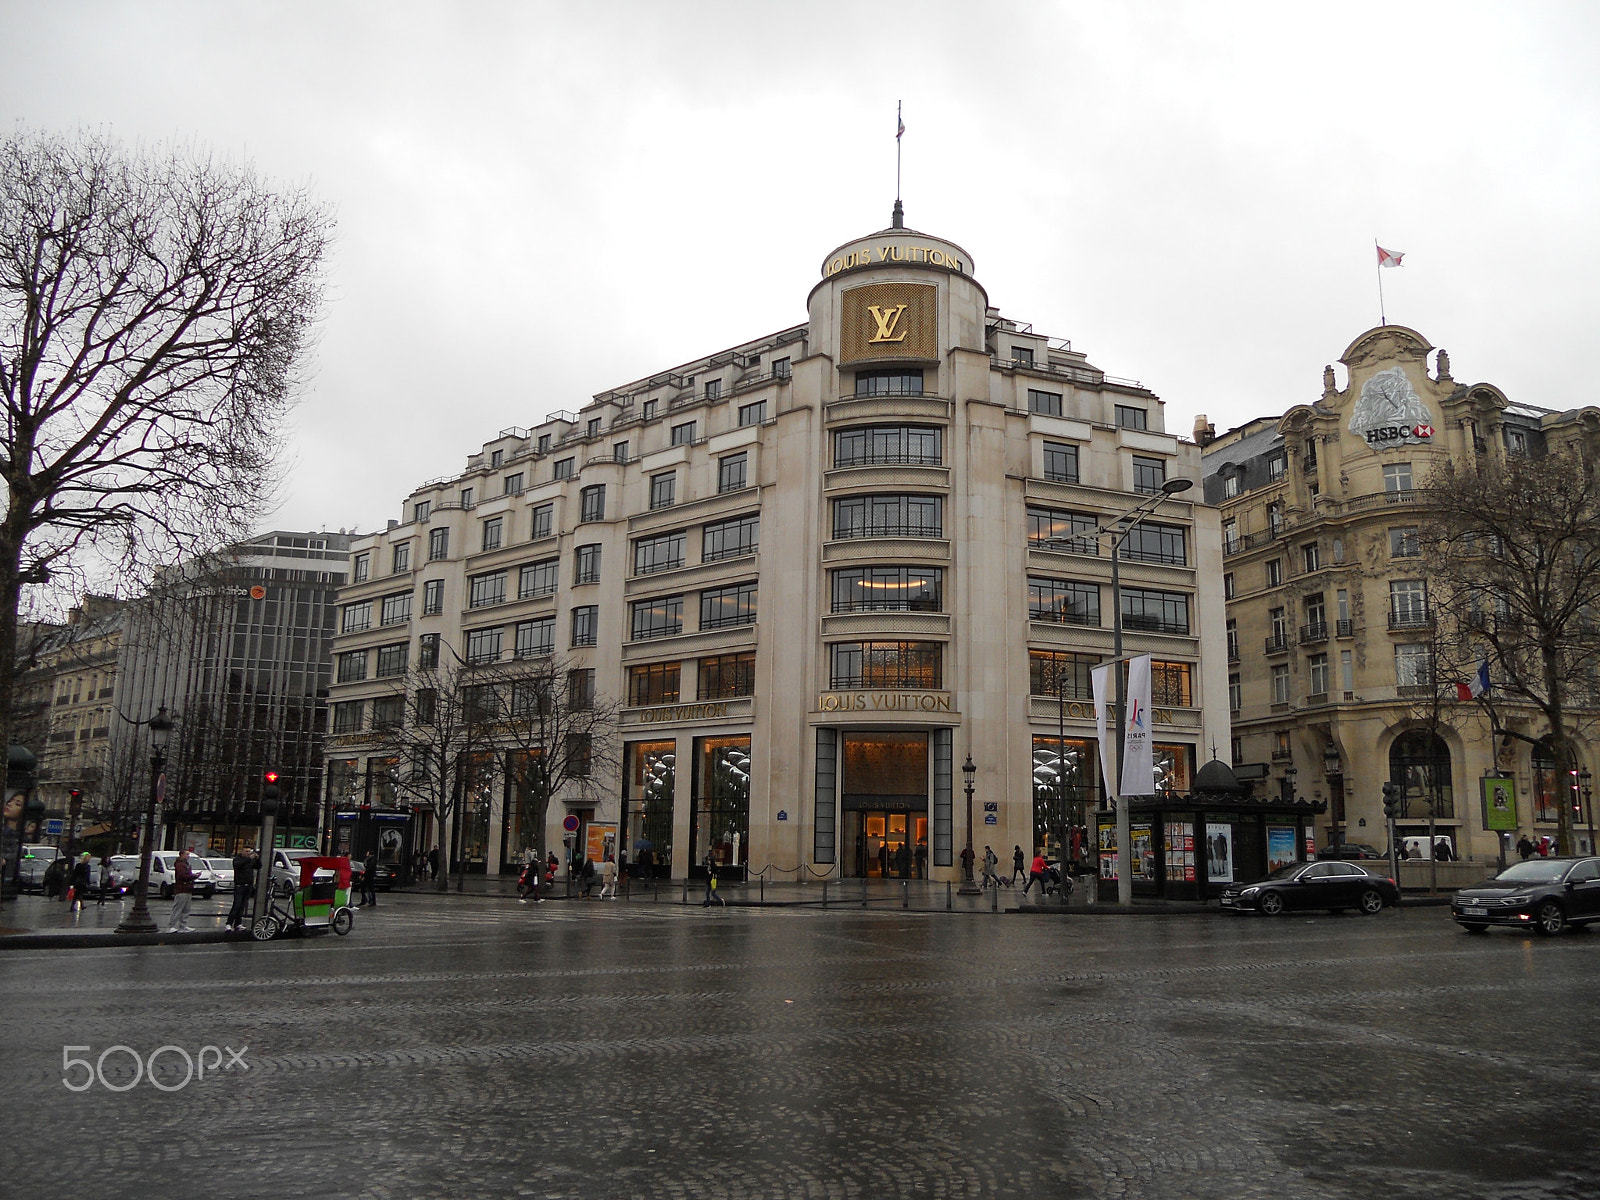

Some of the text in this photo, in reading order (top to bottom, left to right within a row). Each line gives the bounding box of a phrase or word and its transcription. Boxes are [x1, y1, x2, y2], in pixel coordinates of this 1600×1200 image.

[826, 246, 958, 277] LOUIS VUITTON
[1366, 425, 1411, 443] HSBC
[819, 694, 950, 711] LOUIS VUITTON
[1062, 702, 1096, 718] LOU
[640, 703, 727, 723] LOUIS VUITTON
[274, 834, 317, 848] ENZO
